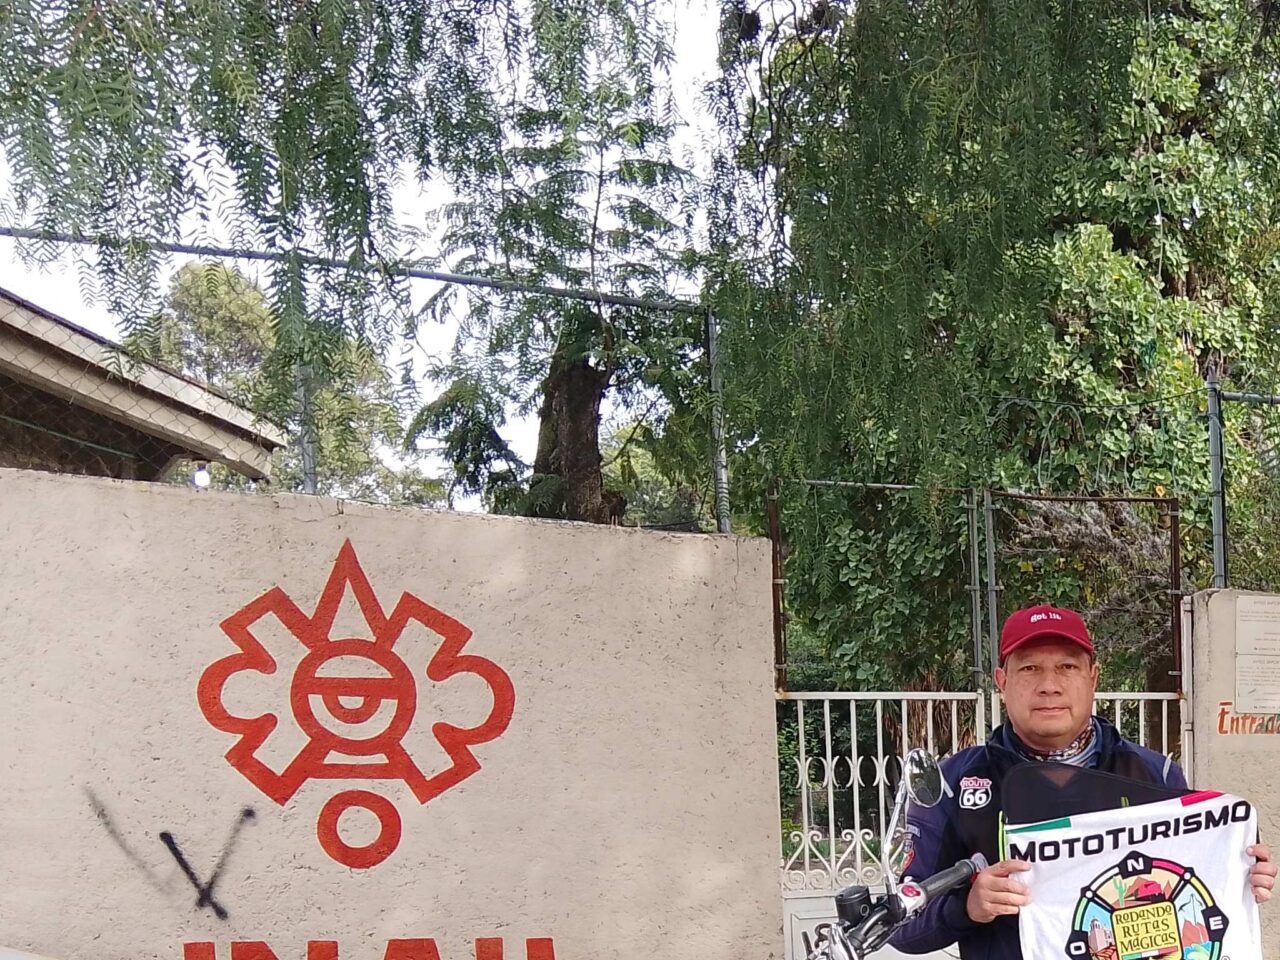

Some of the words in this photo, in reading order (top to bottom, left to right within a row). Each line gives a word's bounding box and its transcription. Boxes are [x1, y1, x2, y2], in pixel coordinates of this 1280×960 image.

[963, 788, 987, 806] 66
[1009, 800, 1252, 863] MOTOTURISMO
[1126, 857, 1145, 872] N
[1208, 916, 1224, 930] E
[1069, 941, 1087, 955] O
